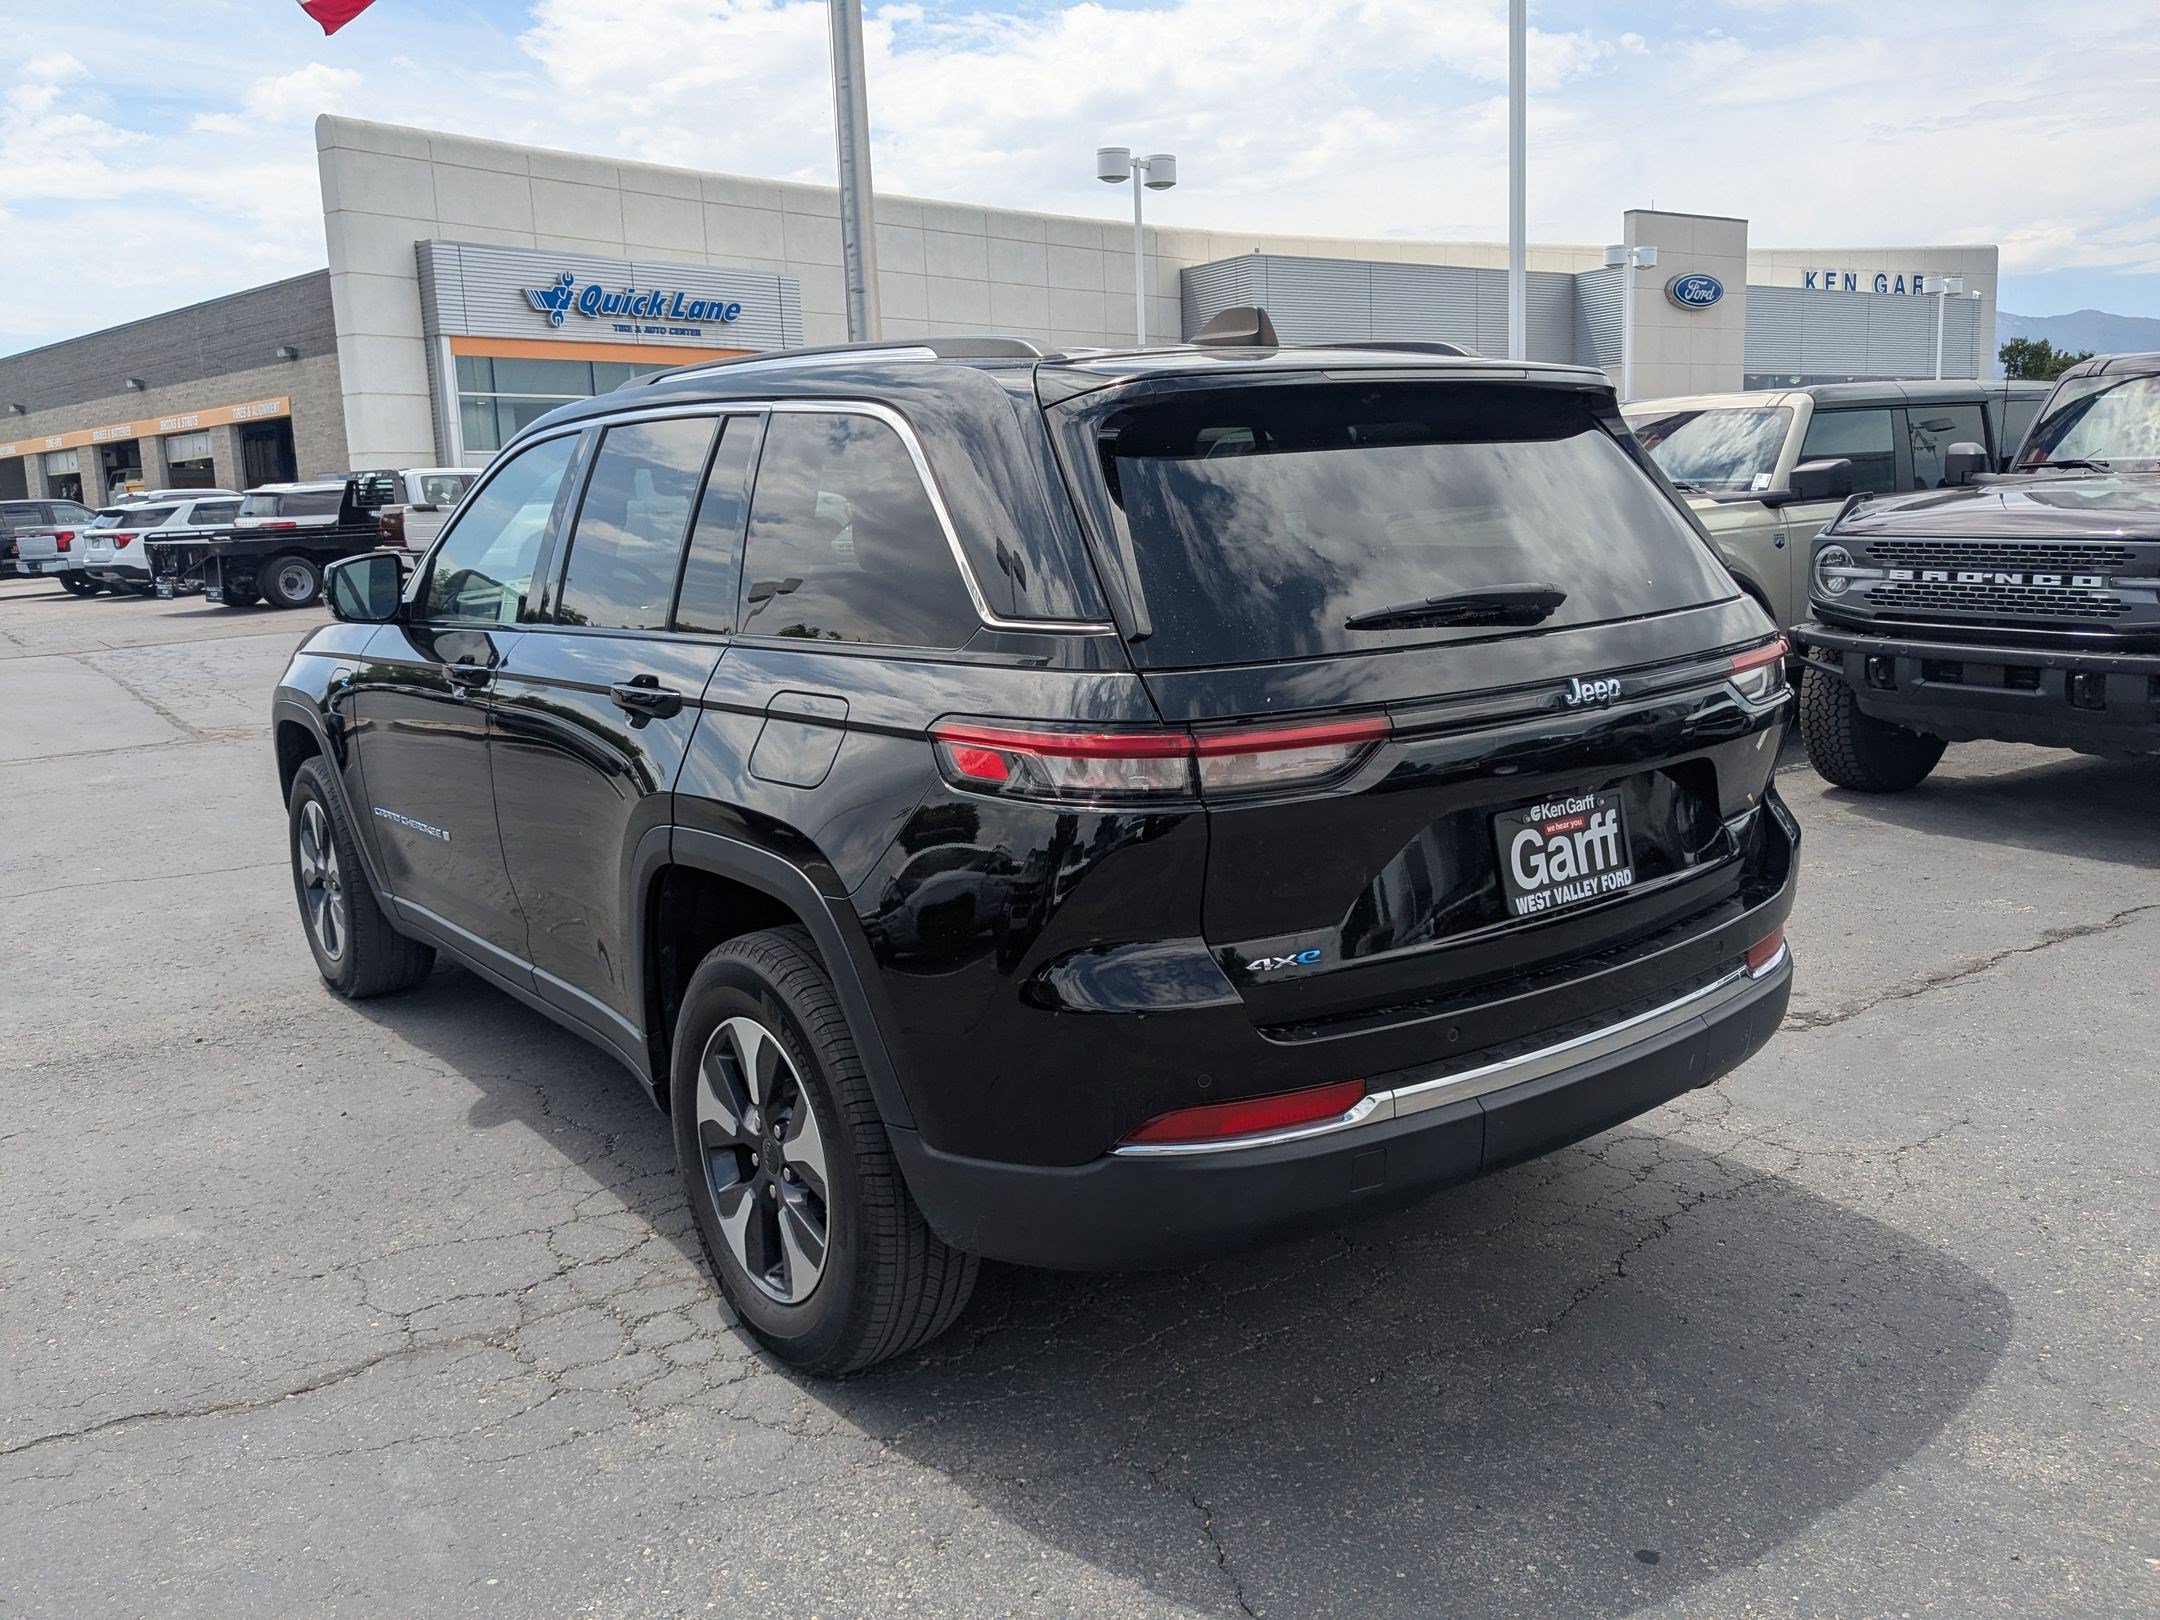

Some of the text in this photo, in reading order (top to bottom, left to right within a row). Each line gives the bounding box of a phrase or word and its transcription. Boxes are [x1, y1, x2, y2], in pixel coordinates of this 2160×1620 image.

[1684, 279, 1716, 301] Ford
[1804, 271, 1925, 296] KEN GAR
[578, 284, 742, 323] Quick Lane
[612, 324, 633, 333] TIRE
[644, 325, 667, 335] AUTO
[669, 327, 702, 337] CENTER
[232, 406, 247, 419] TIRES
[1888, 569, 2103, 588] BRONCO
[1565, 678, 1621, 706] Jeep
[1541, 794, 1595, 820] Ken Garff
[401, 816, 443, 838] CHEROKEE
[1546, 819, 1583, 833] we hear you
[1511, 809, 1618, 890] Garff
[1515, 869, 1632, 915] WEST VALLEY FORD
